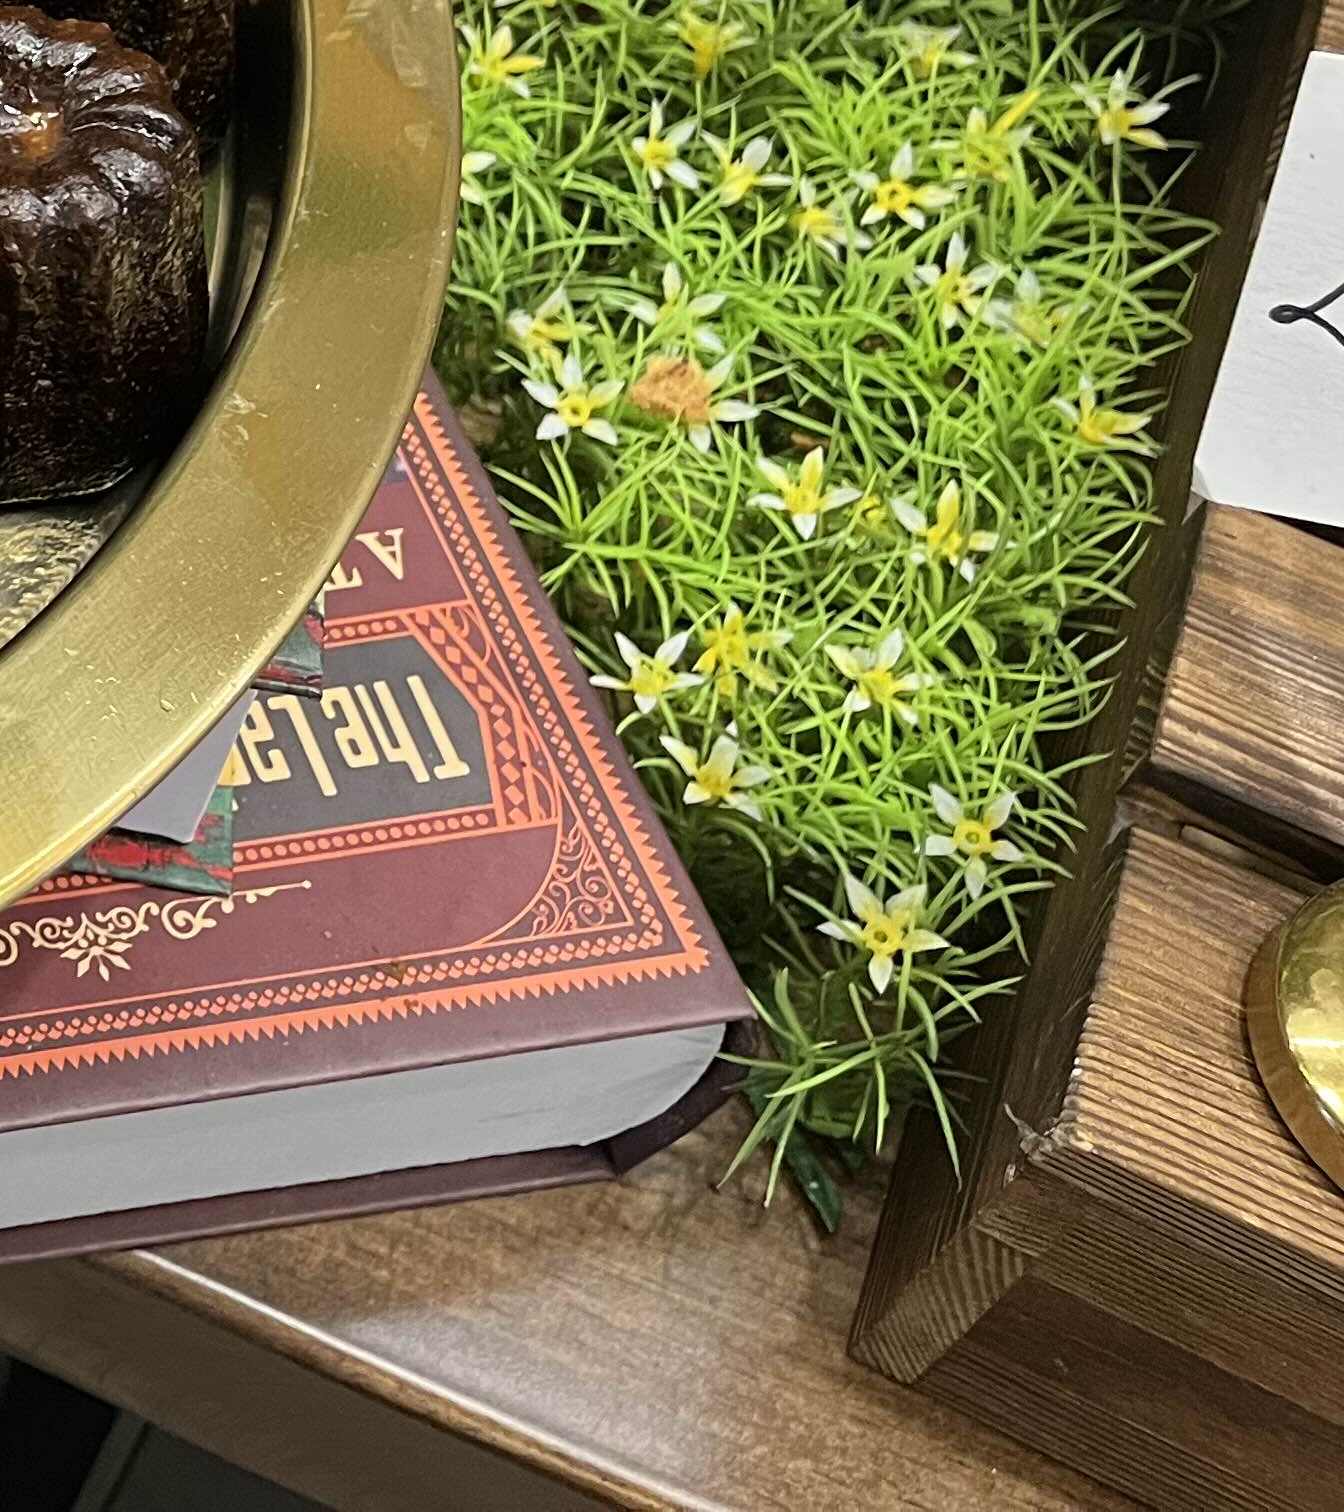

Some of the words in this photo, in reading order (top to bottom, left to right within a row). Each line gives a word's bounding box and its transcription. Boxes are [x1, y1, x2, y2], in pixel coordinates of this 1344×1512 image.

[355, 528, 404, 580] A
[218, 695, 337, 811] La
[319, 675, 470, 783] The
